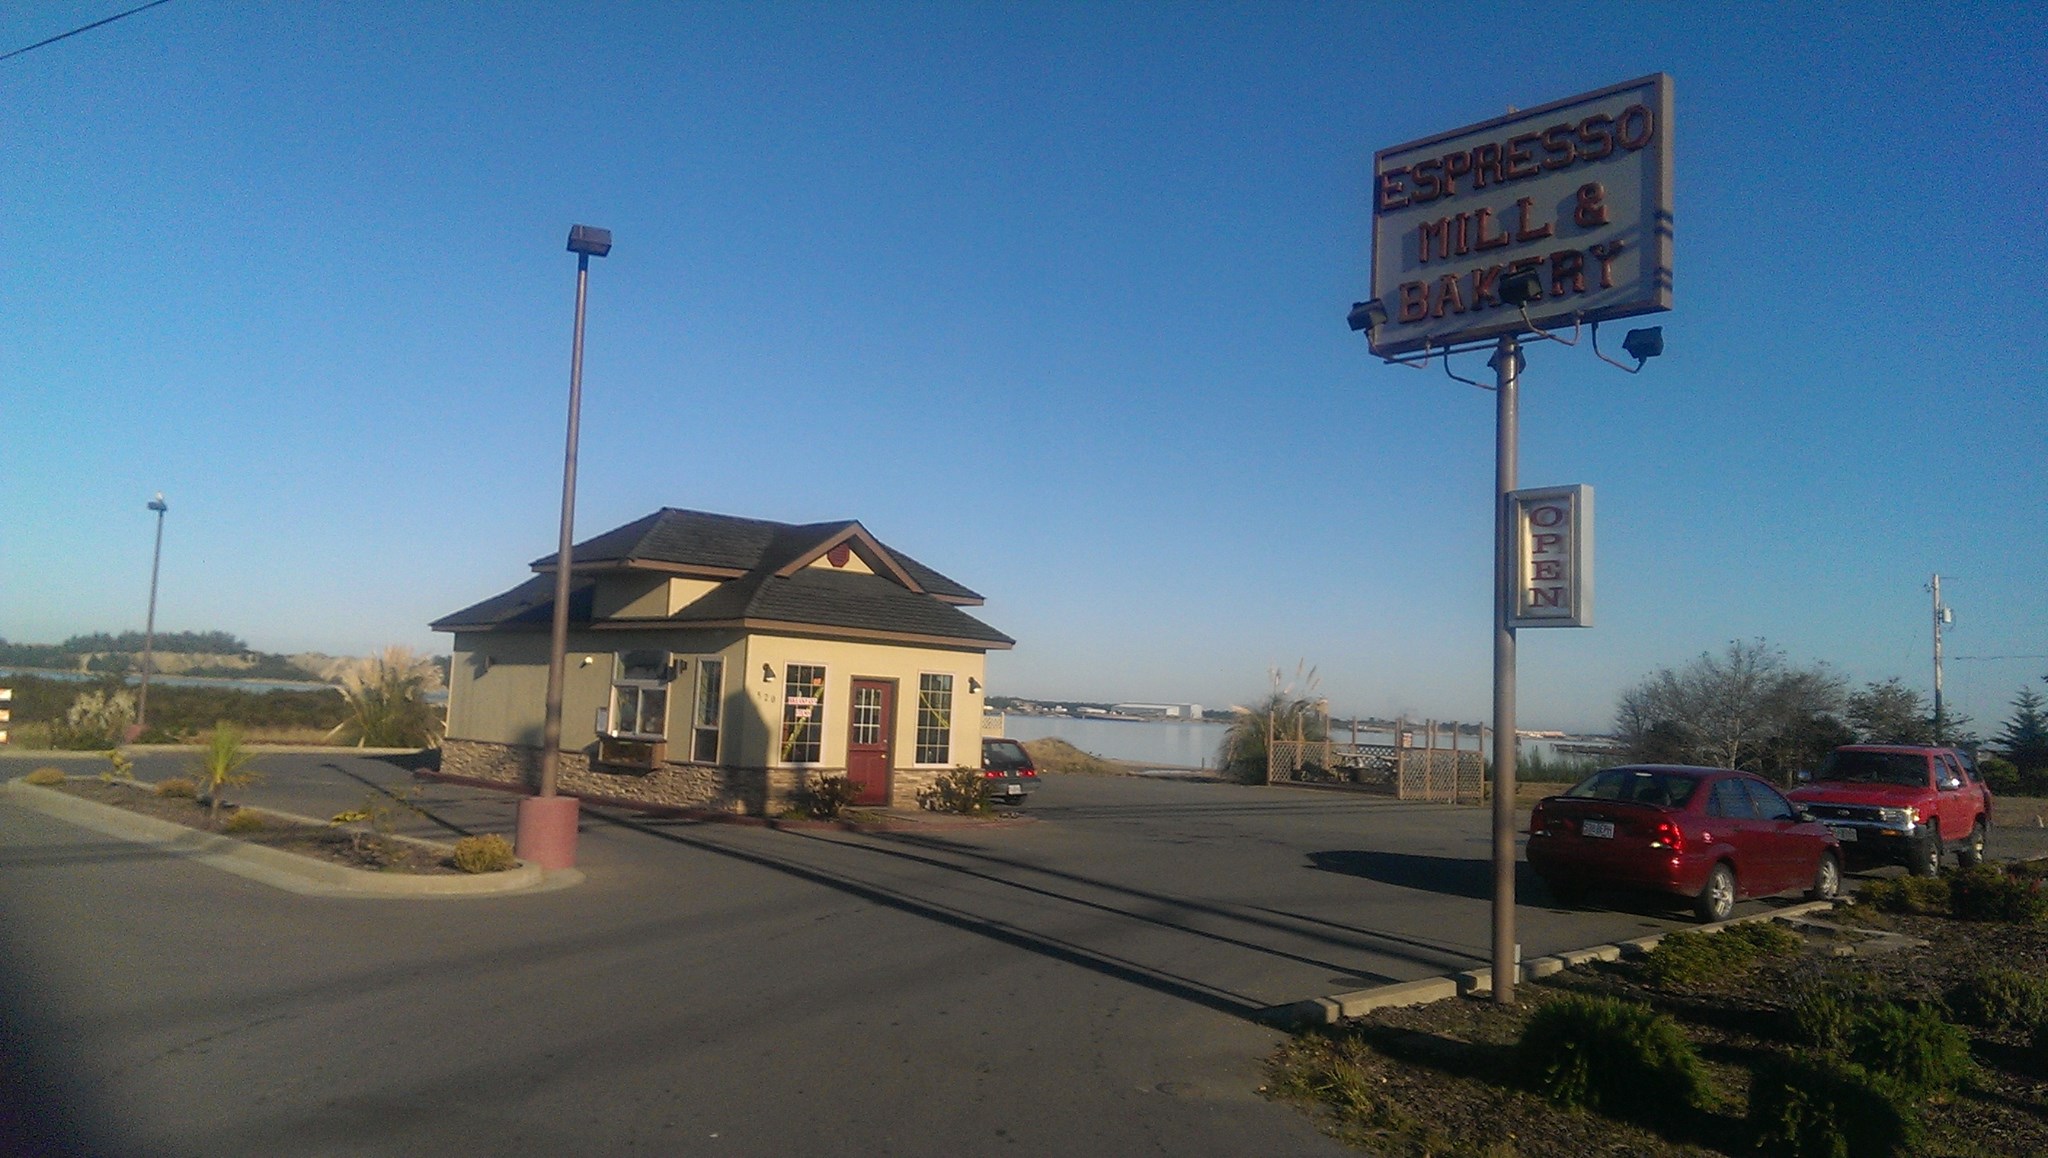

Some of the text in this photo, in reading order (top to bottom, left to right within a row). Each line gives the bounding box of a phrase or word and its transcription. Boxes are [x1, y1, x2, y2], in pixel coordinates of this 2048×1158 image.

[1380, 104, 1654, 211] ESPRESSO
[1418, 181, 1609, 263] MILL &
[1529, 505, 1564, 608] OPEN
